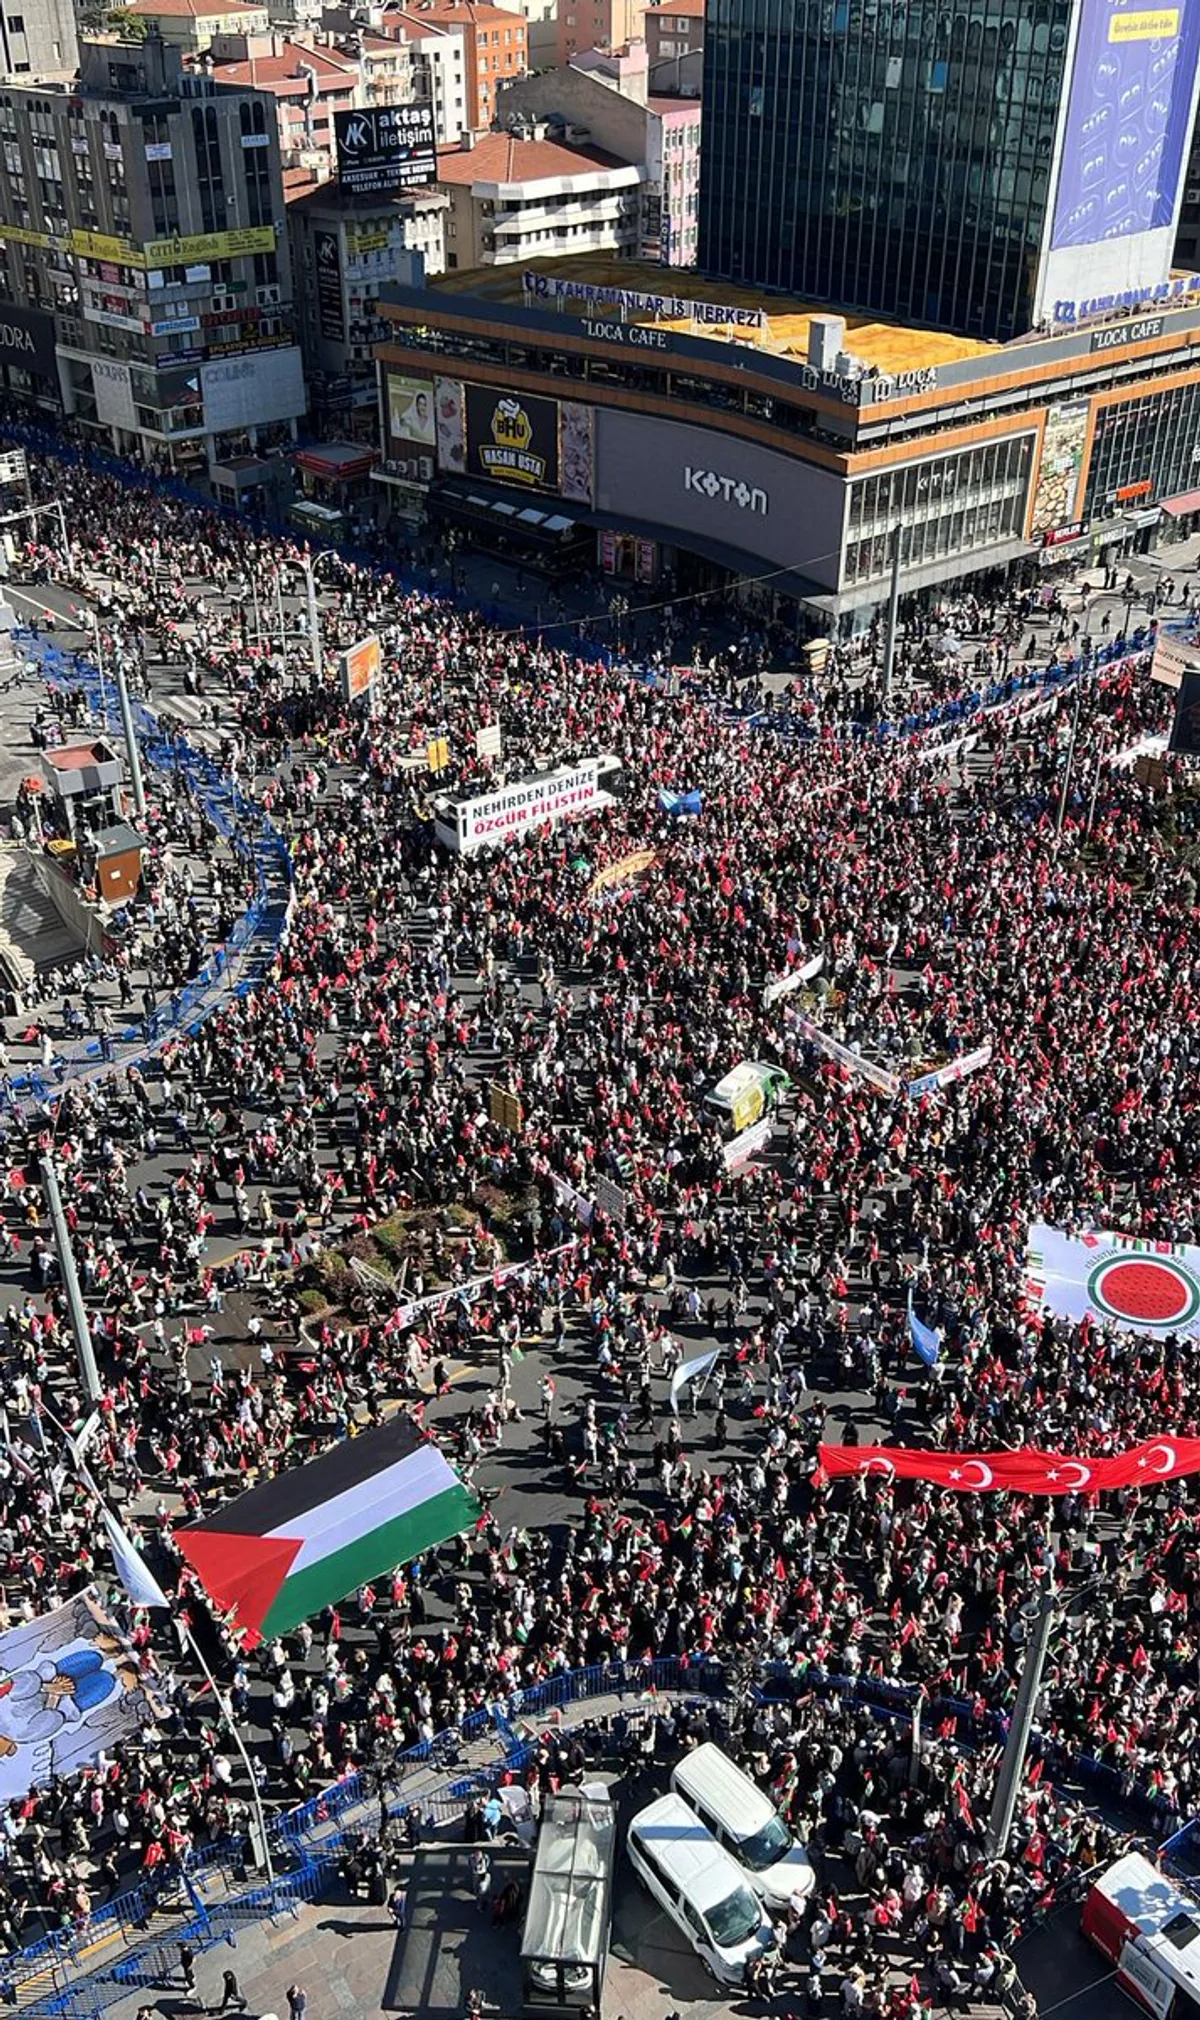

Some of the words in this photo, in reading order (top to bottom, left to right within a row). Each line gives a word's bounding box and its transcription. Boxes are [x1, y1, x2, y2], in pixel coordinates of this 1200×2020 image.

[379, 107, 431, 127] aktaş
[380, 126, 432, 148] iletişim
[351, 180, 382, 193] TELEFON
[555, 281, 664, 312] KAHRAMANLAR
[629, 328, 667, 348] CAFE
[1131, 319, 1161, 339] CAFE
[823, 370, 858, 395] LOCA
[898, 366, 938, 388] LOCA
[496, 418, 525, 439] BHU
[517, 454, 542, 476] USTA
[472, 784, 545, 819] NEHİRDEN
[547, 769, 596, 794] DENİZE
[473, 807, 528, 836] ÖZGÜR
[531, 786, 595, 815] FİLİSTİN
